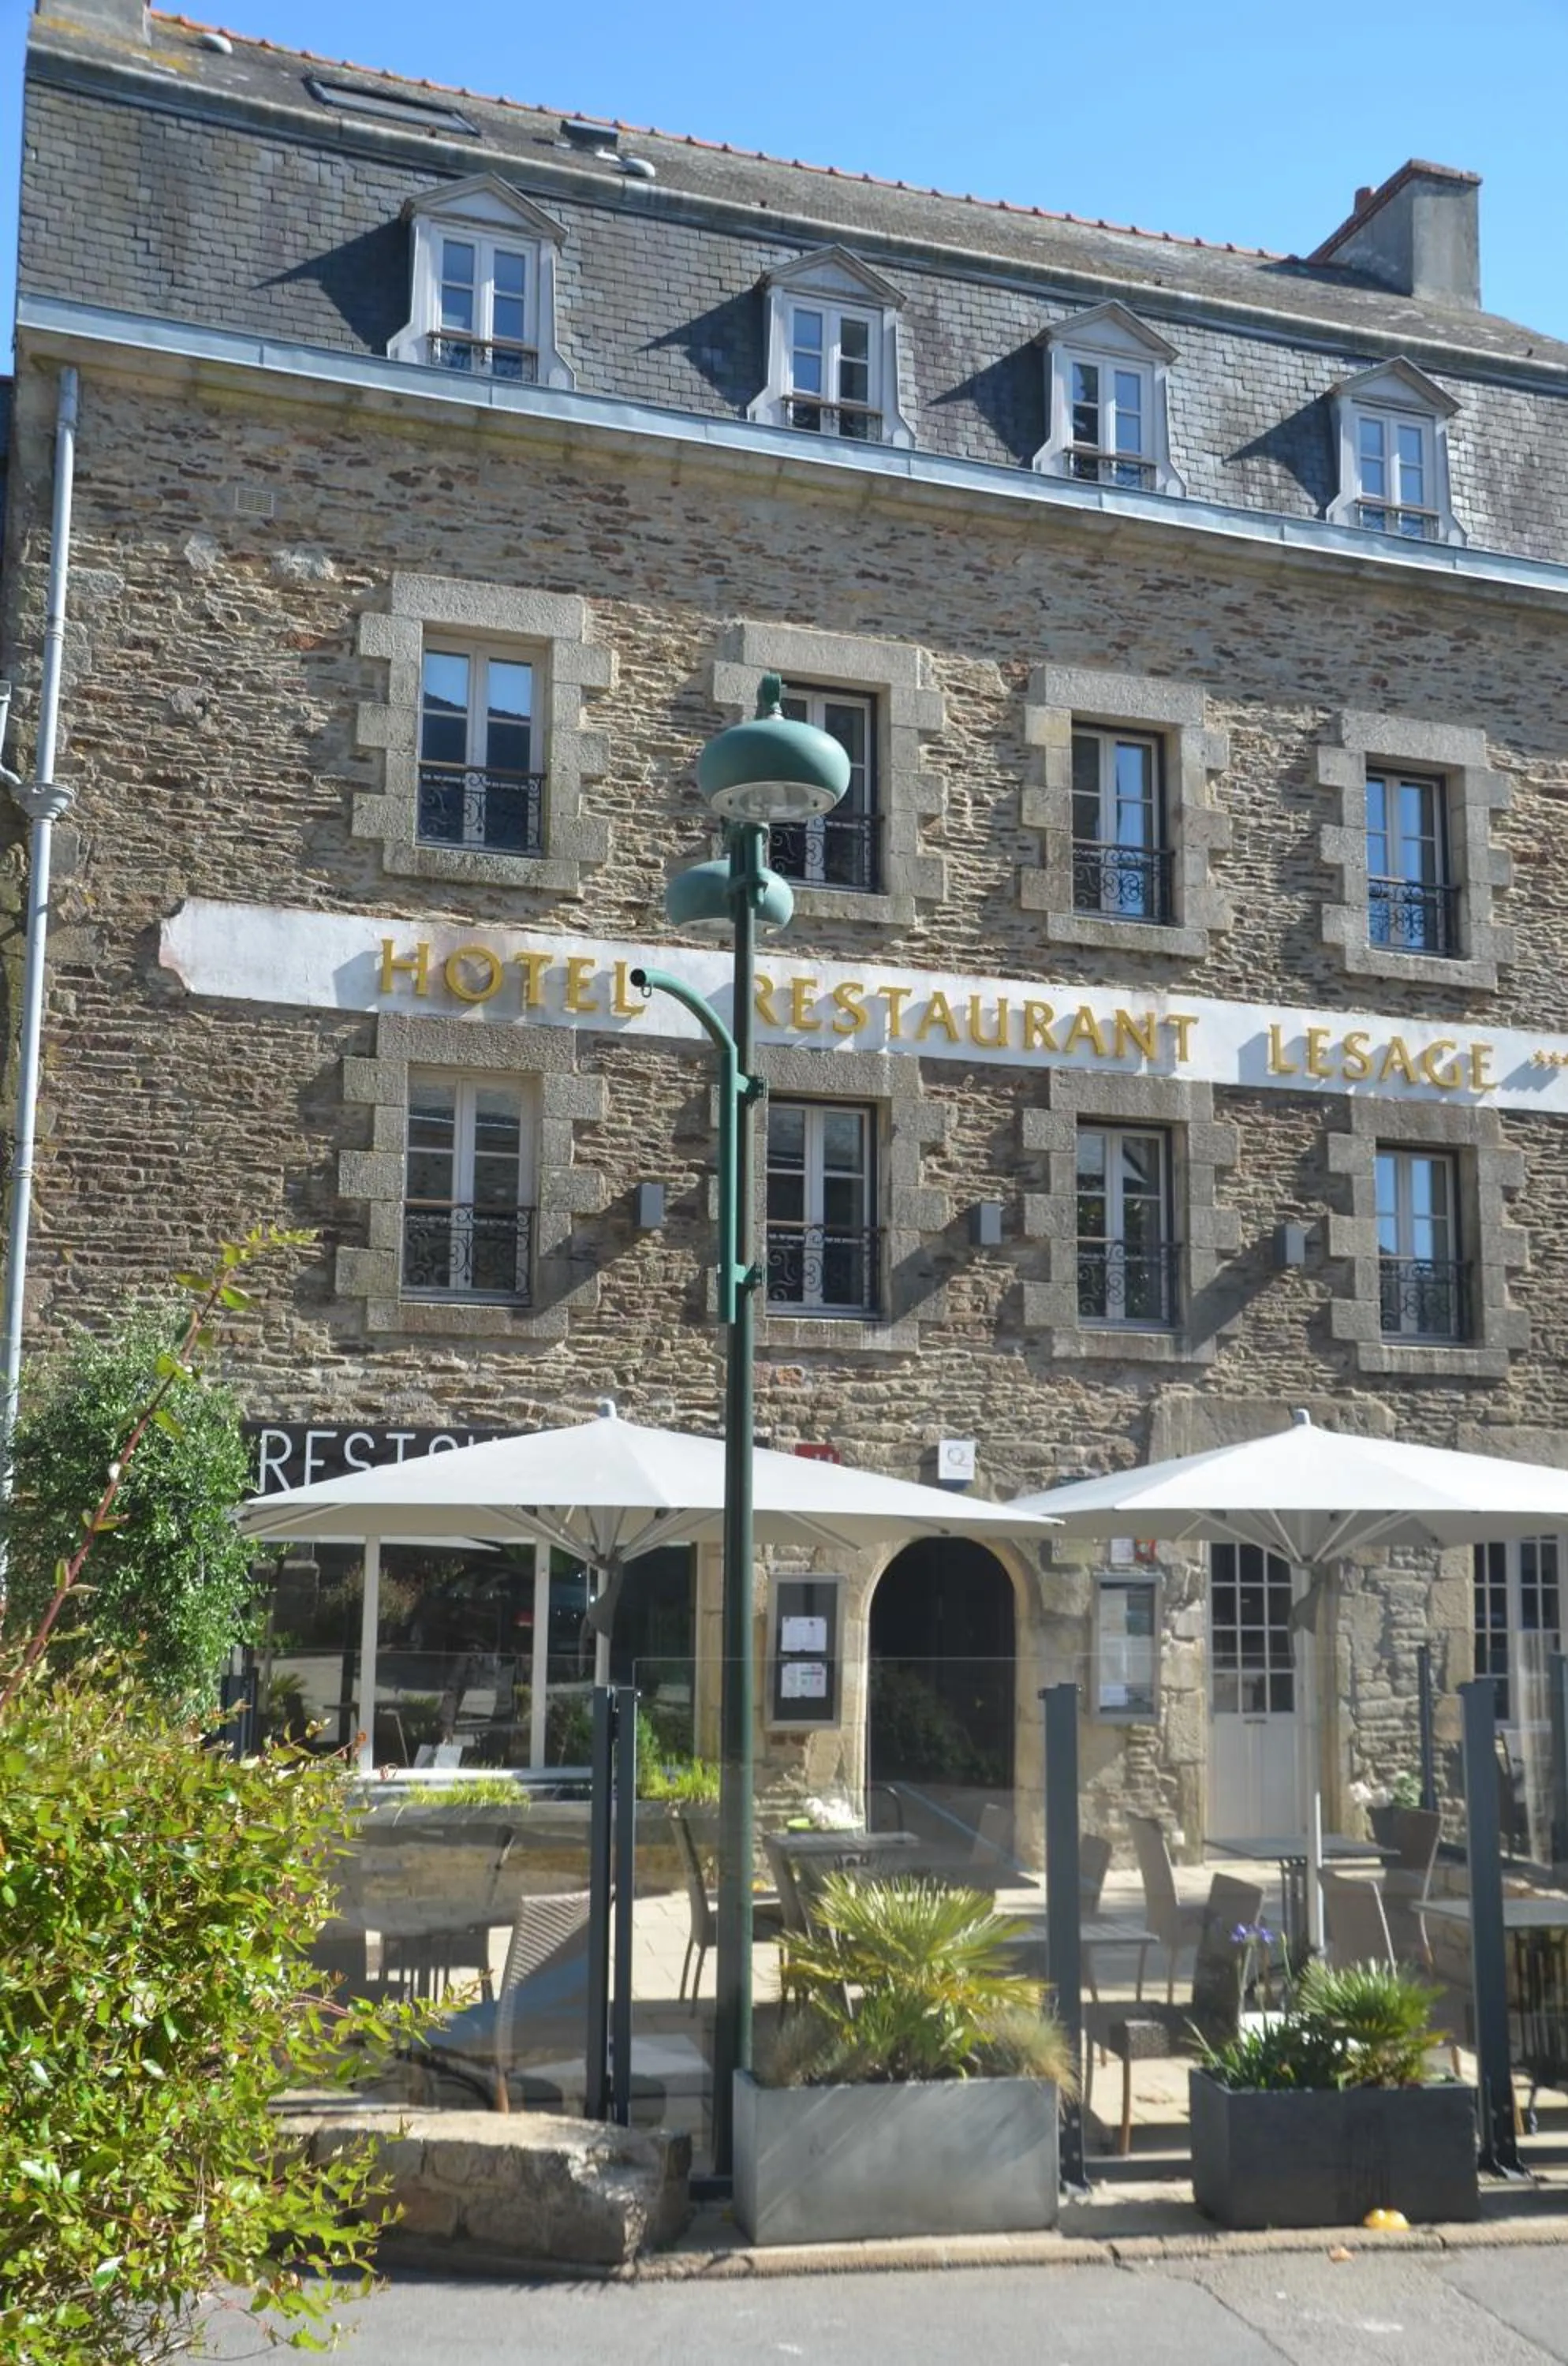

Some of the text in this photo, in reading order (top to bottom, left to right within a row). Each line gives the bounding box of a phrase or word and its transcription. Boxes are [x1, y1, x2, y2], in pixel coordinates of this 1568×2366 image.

[379, 938, 1499, 1092] HOTEL RESTAURANT LESAGE
